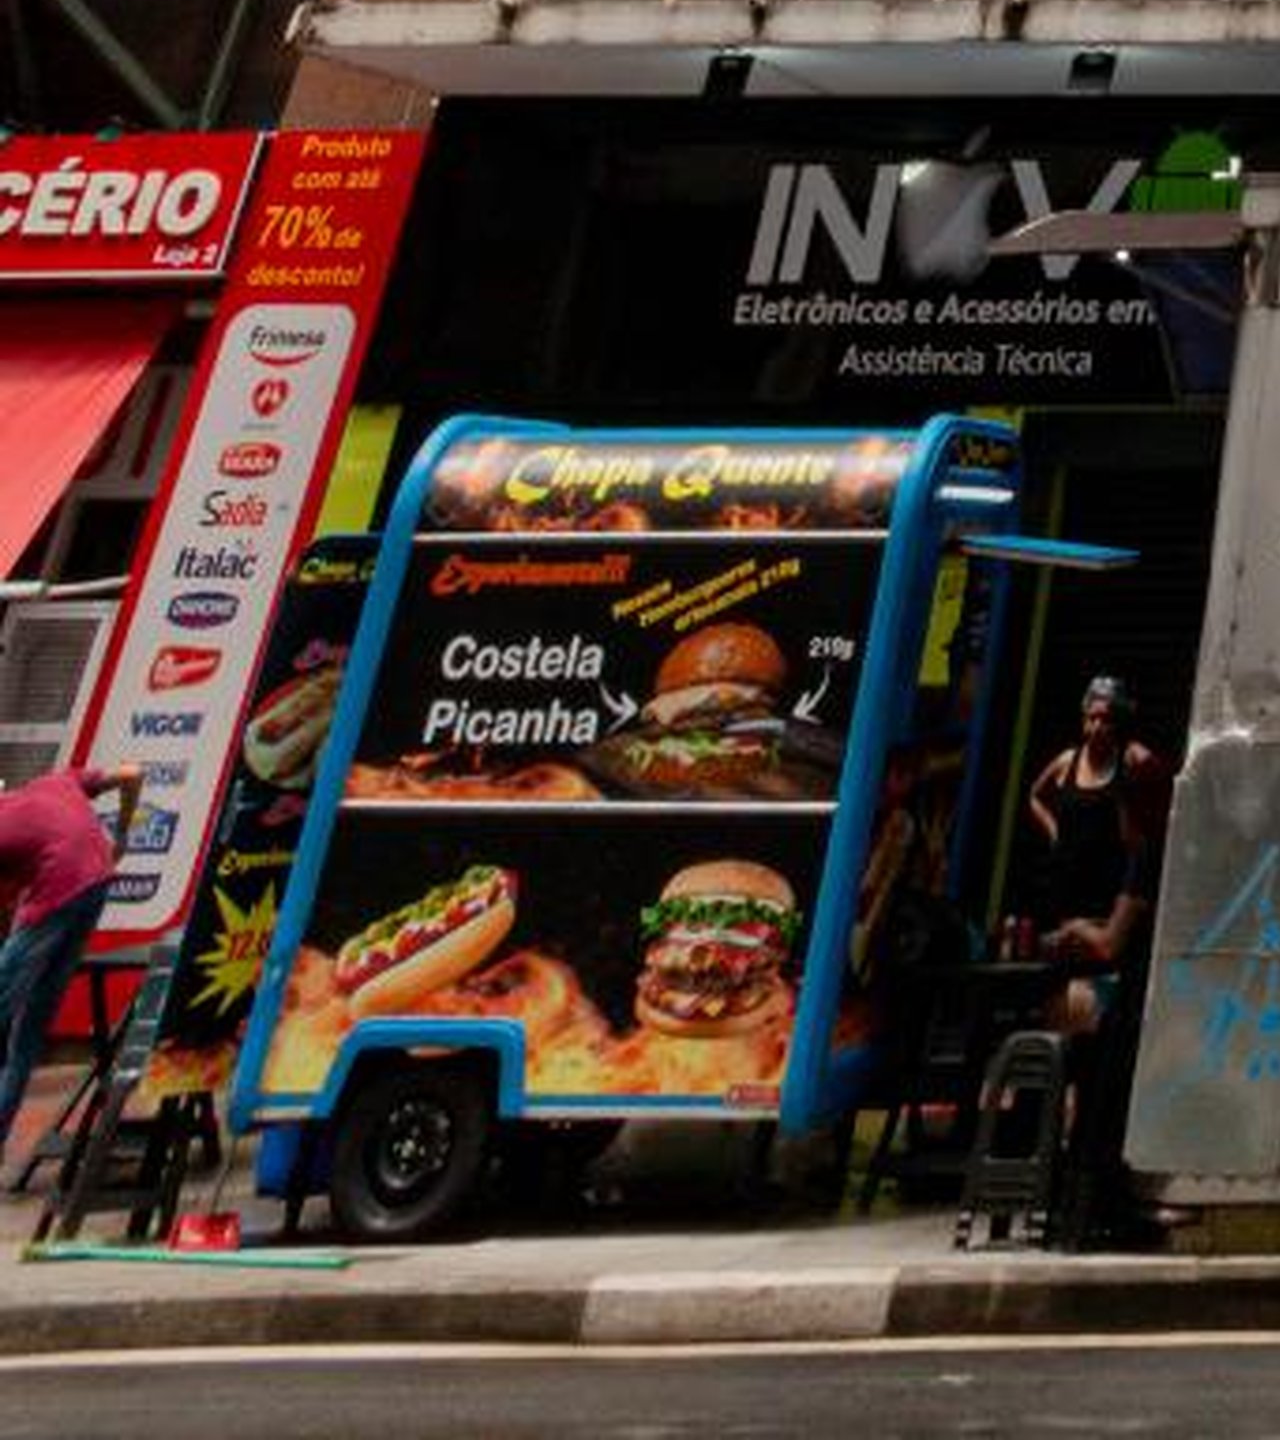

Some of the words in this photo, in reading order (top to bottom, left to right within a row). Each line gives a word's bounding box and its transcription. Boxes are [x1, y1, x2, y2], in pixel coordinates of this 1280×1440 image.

[301, 134, 393, 157] Produto
[291, 172, 341, 190] com
[345, 167, 382, 190] até
[258, 205, 335, 248] 70%
[333, 229, 365, 248] de
[246, 264, 366, 288] desconto!
[734, 289, 908, 326] Eletrônicos
[912, 301, 933, 325] e
[936, 289, 1098, 326] Acessórios
[838, 341, 985, 377] Assistência
[994, 341, 1093, 377] Técnica
[199, 489, 268, 527] Sadia
[174, 547, 257, 580] Italac
[441, 634, 605, 679] Costela
[422, 697, 598, 745] Picanha
